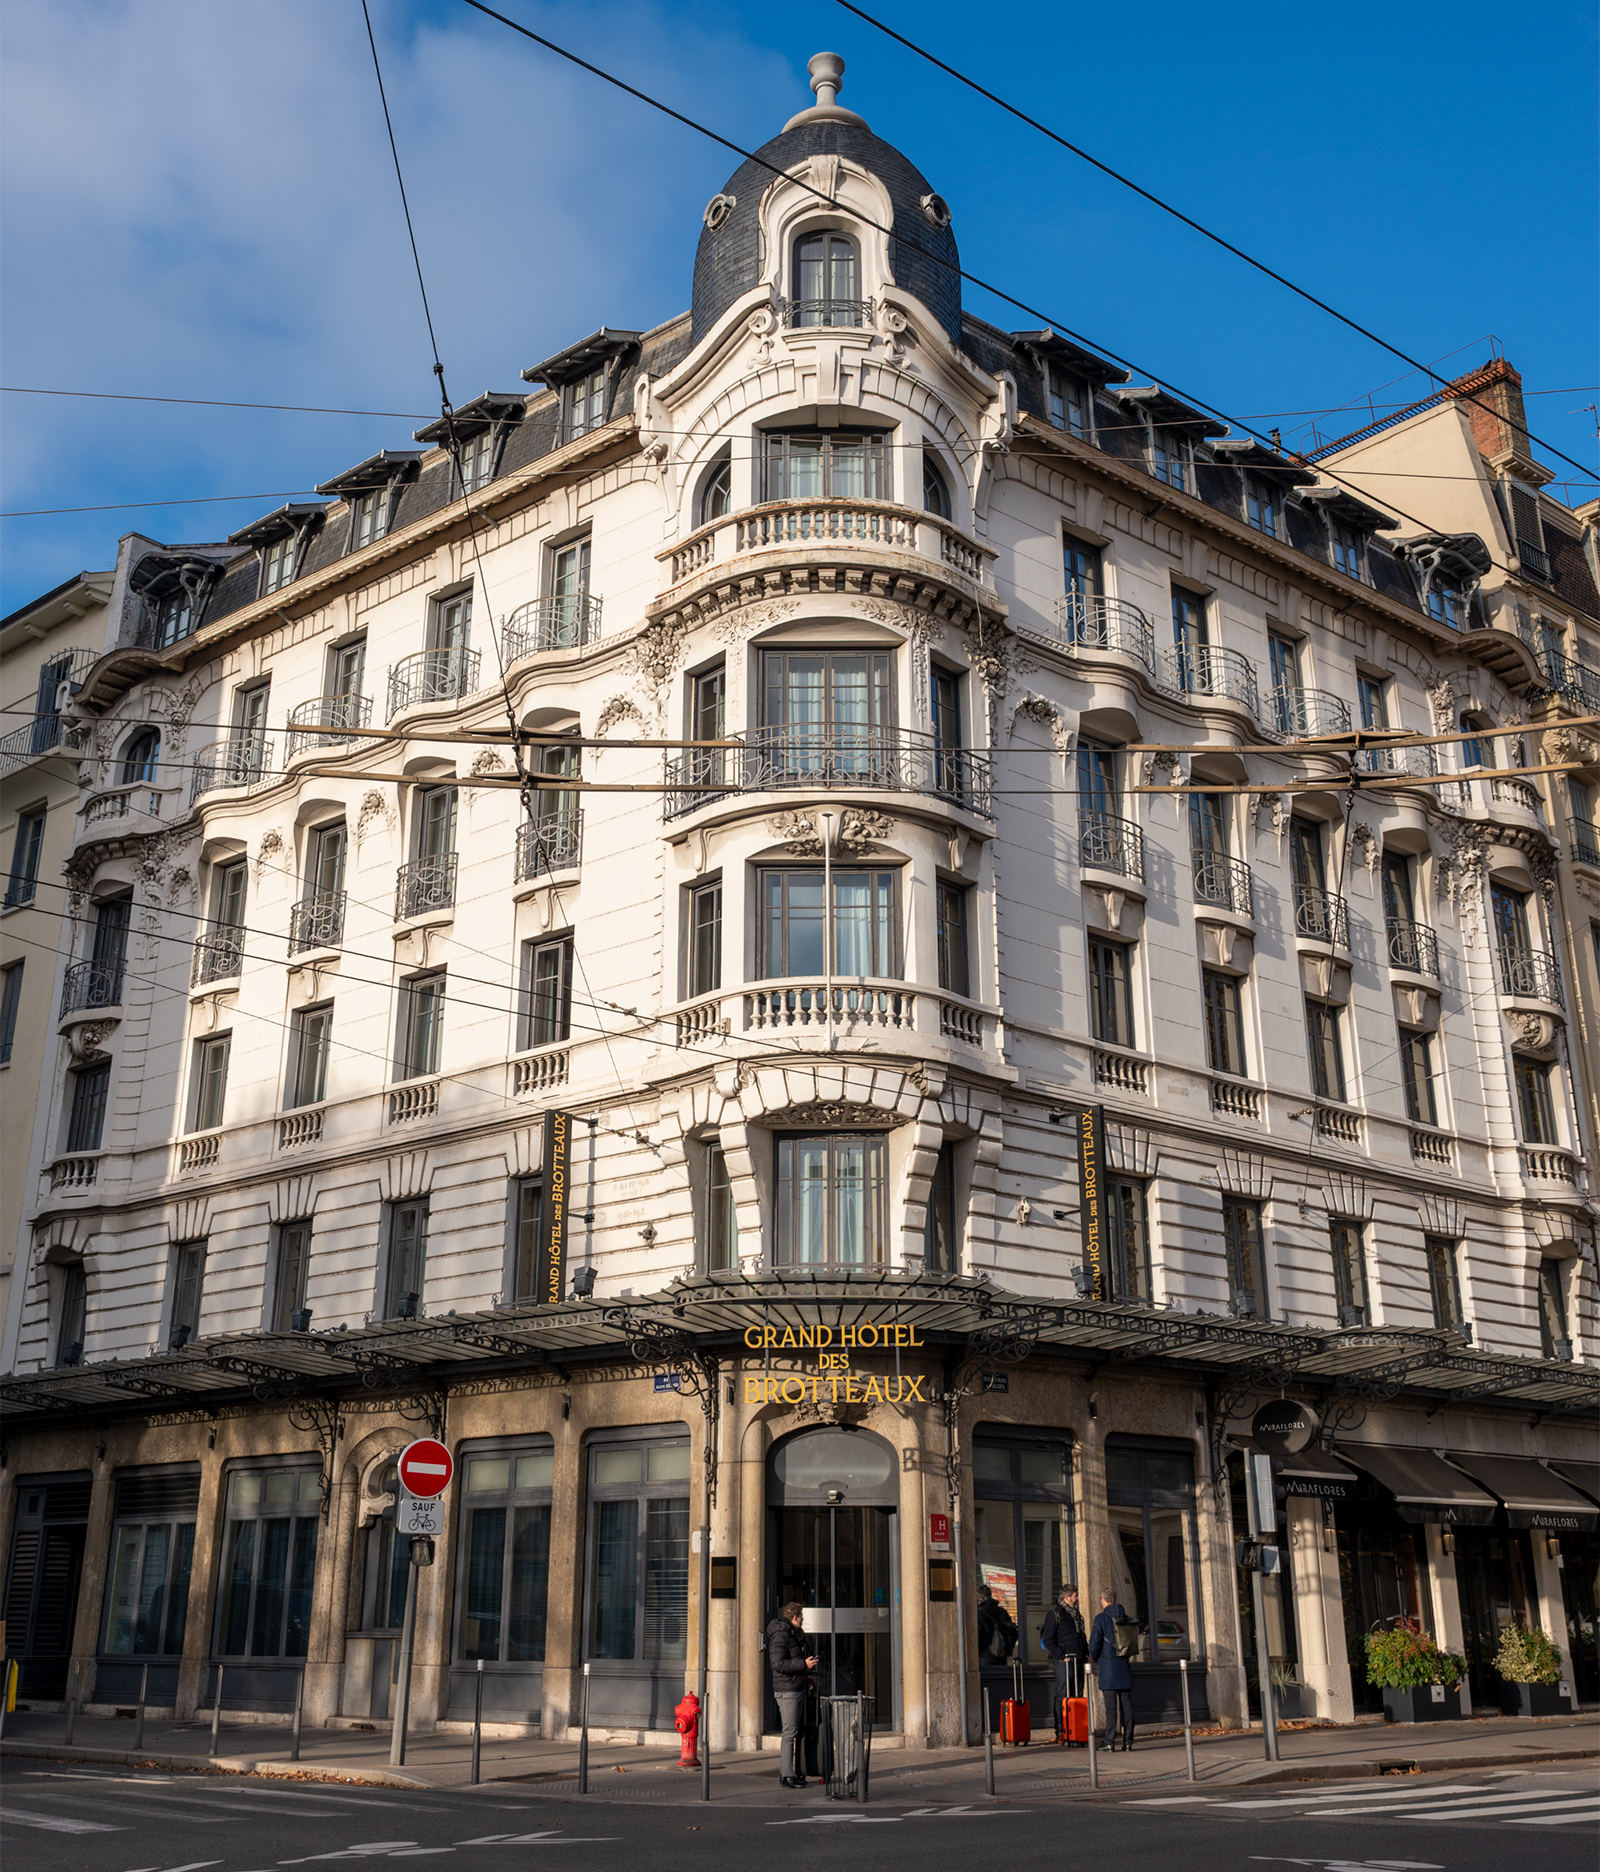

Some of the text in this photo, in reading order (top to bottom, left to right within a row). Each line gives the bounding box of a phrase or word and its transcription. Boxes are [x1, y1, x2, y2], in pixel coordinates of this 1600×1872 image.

[552, 1113, 566, 1202] BROTTEAUX
[1082, 1108, 1102, 1302] RAND HÔTEL DES BROTTEAUX
[548, 1222, 562, 1265] HÔTEL
[549, 1267, 560, 1304] RAND
[744, 1319, 925, 1348] GRAND HÔTEL
[818, 1353, 850, 1370] DES
[744, 1375, 927, 1404] BROTTEAUX
[1259, 1421, 1305, 1432] MIRAFLORES
[1286, 1480, 1346, 1497] MIRAFLORES
[411, 1502, 436, 1512] SAUF
[939, 1520, 946, 1530] H
[1532, 1514, 1579, 1528] MIRAFLORES
